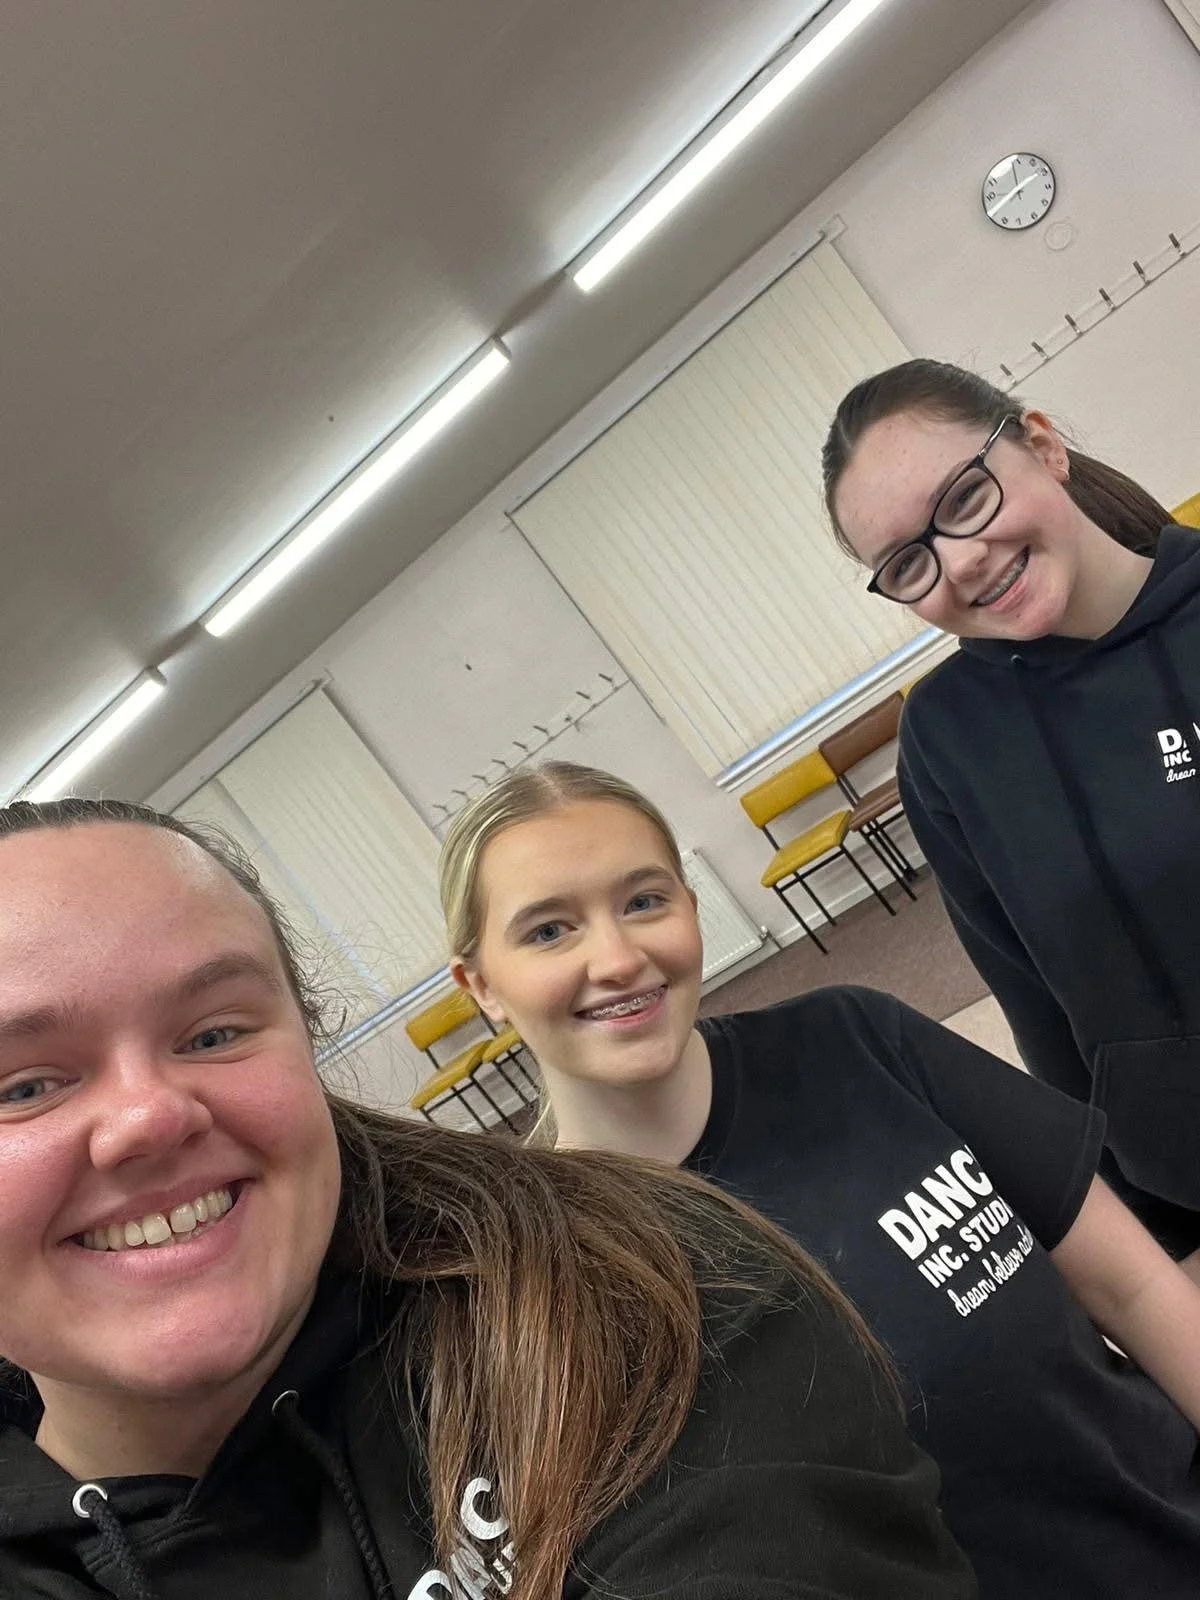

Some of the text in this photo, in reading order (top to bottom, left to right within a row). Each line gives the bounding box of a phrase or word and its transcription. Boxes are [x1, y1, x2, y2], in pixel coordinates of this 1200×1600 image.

[986, 191, 996, 202] 10
[877, 1144, 993, 1261] DANC
[917, 1195, 1014, 1289] INC. STUDI
[946, 1278, 997, 1317] dream
